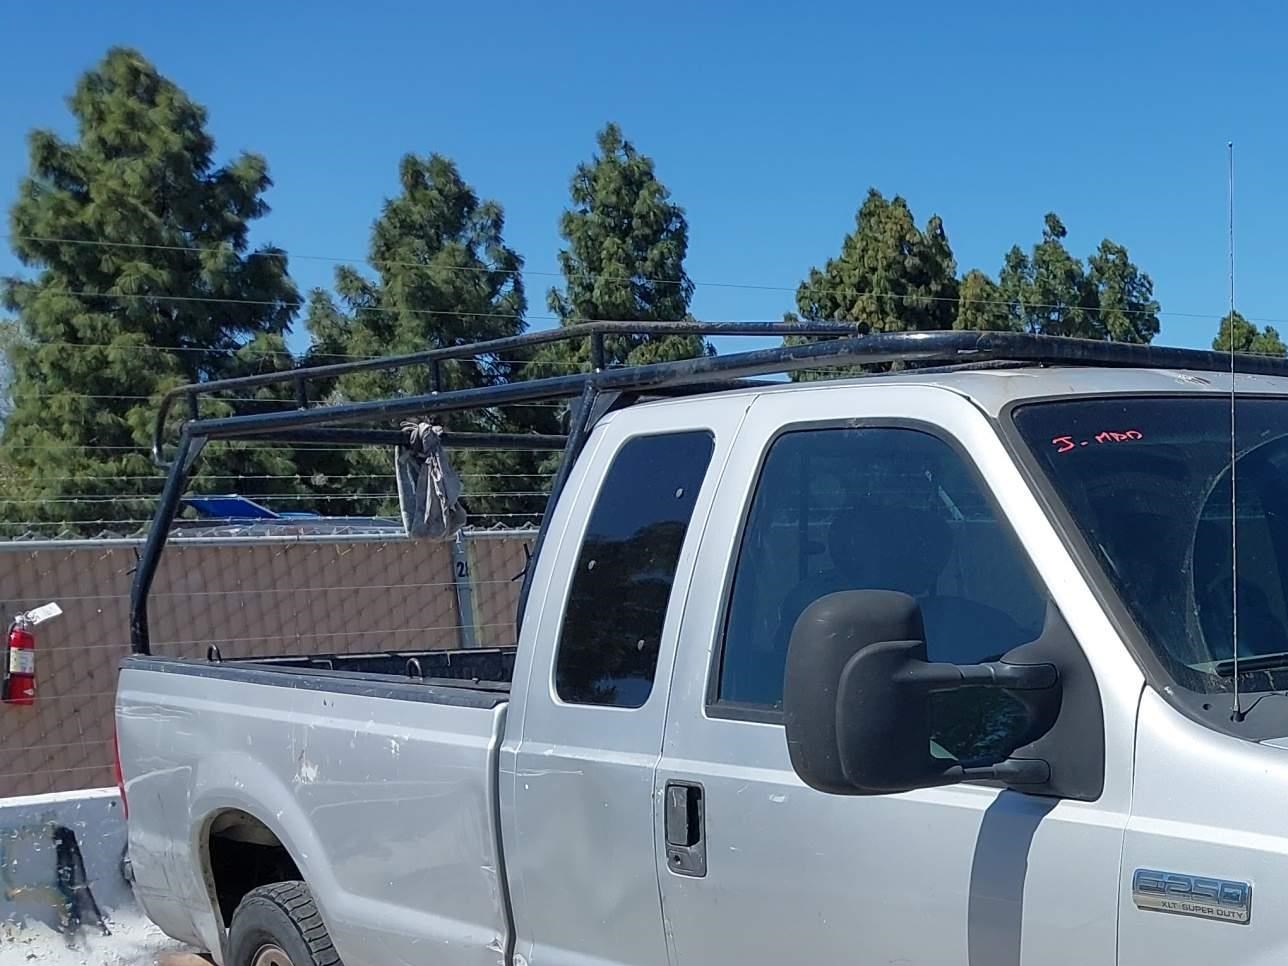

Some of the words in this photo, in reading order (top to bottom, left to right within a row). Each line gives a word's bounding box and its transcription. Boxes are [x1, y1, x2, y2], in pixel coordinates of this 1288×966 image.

[1161, 901, 1178, 909] XLT
[1182, 904, 1214, 914] SUPER
[1216, 908, 1244, 919] DUTY
